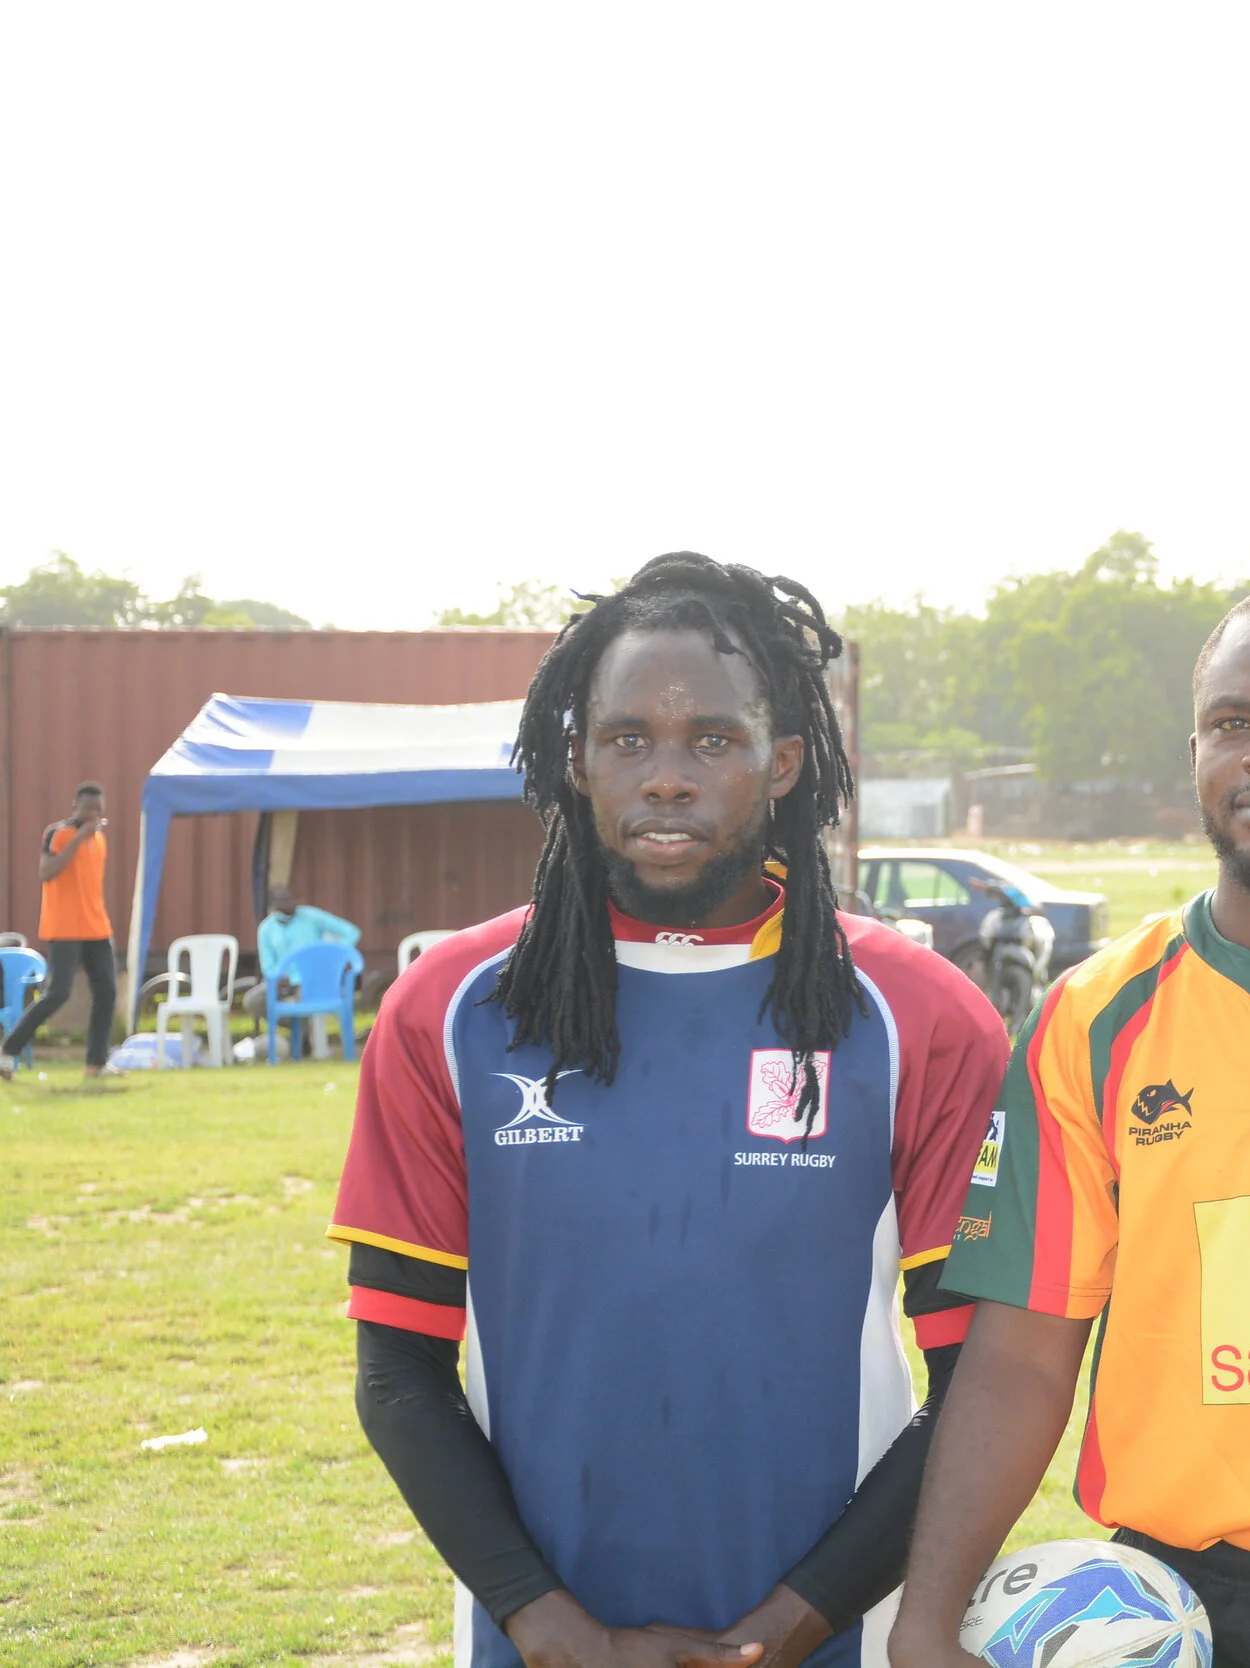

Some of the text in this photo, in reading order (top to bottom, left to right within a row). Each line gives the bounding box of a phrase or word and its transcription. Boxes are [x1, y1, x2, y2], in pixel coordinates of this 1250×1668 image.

[494, 1126, 583, 1146] GILBERT
[1128, 1121, 1192, 1136] PIRANHA
[1135, 1130, 1184, 1146] RUGBY
[734, 1152, 836, 1168] SURREY RUGBY
[967, 1563, 1038, 1607] re
